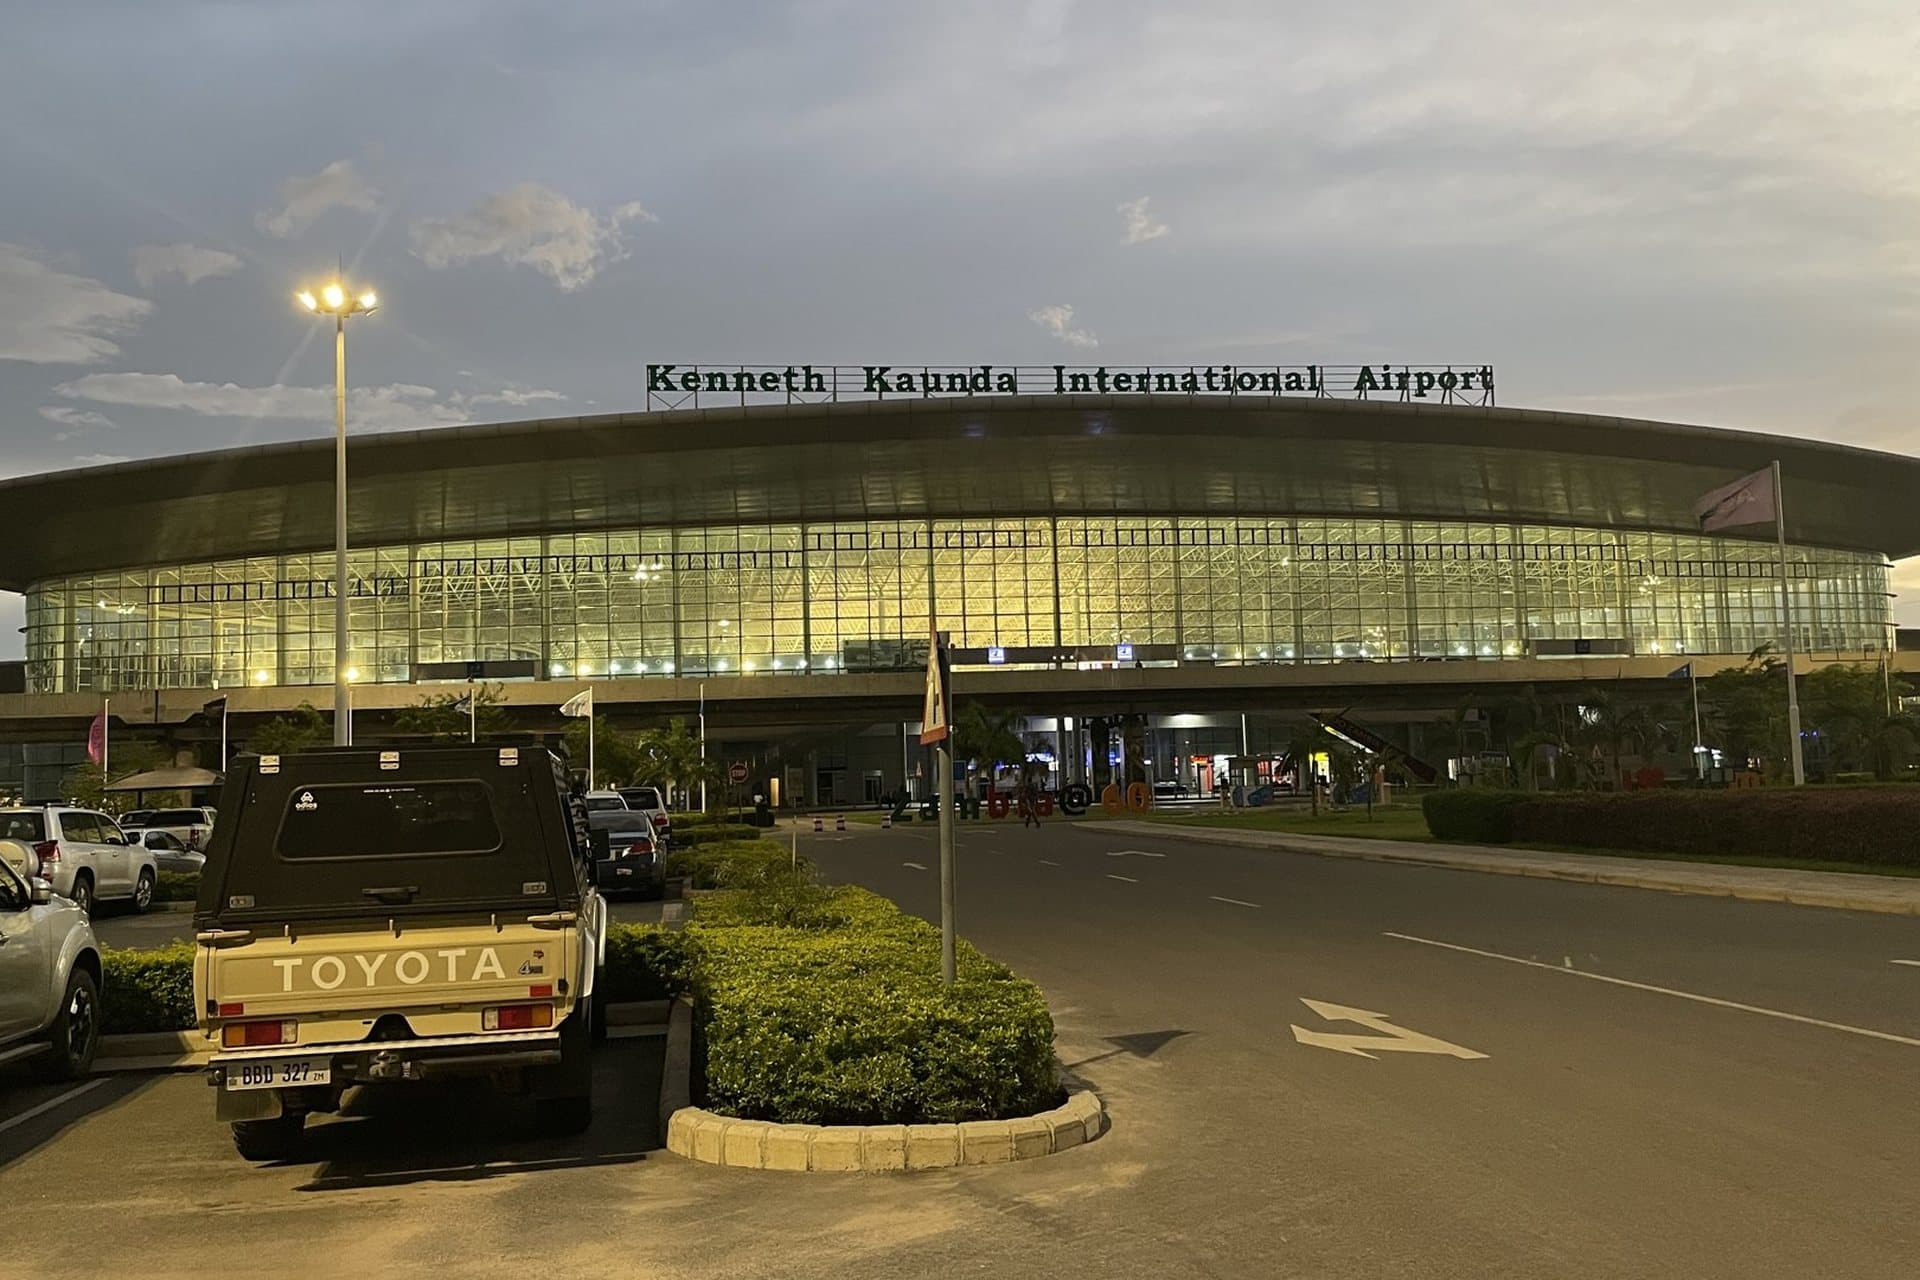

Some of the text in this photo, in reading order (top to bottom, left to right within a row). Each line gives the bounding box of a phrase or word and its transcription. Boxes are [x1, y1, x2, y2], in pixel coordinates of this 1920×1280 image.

[648, 364, 1493, 398] Kenneth Kaunda International Airport
[273, 947, 506, 992] TOYOTA
[243, 1065, 273, 1085] BBD
[282, 1062, 310, 1082] 327
